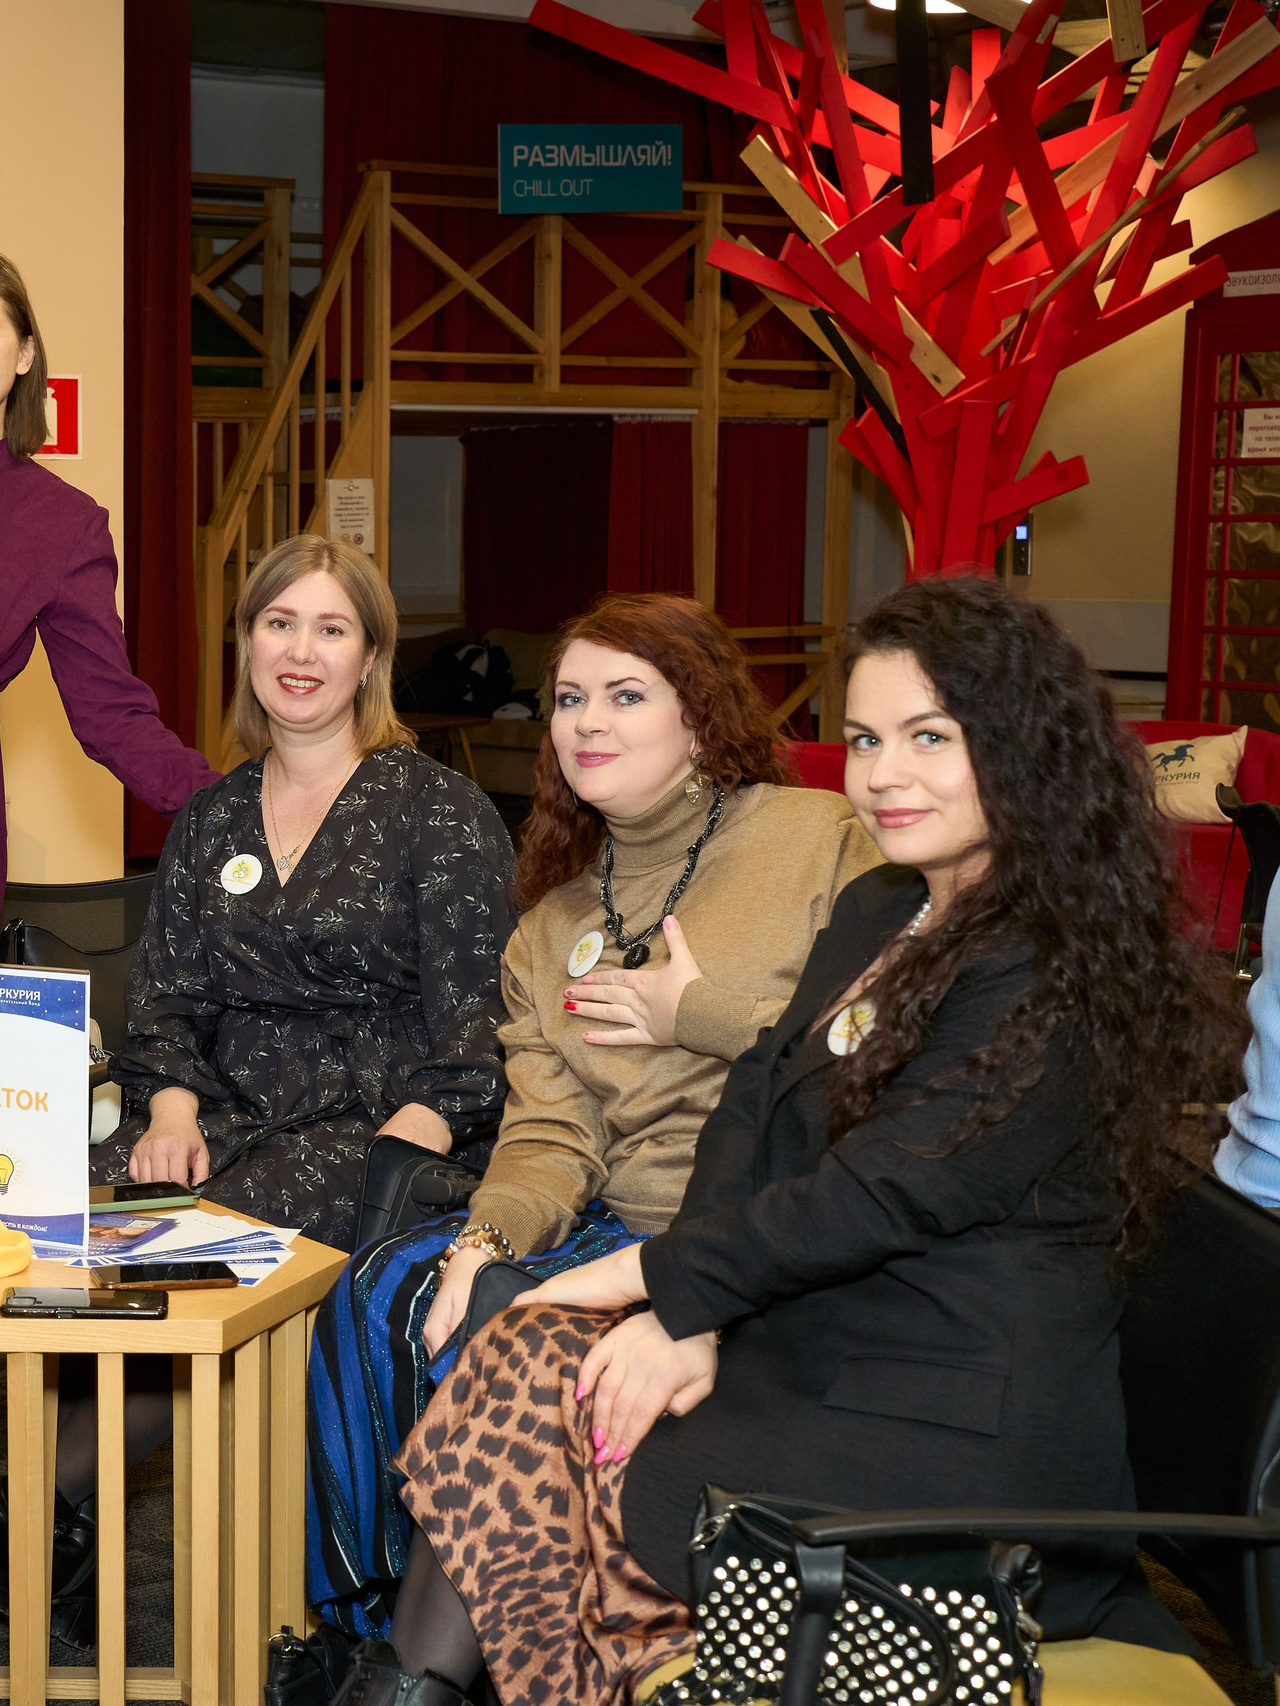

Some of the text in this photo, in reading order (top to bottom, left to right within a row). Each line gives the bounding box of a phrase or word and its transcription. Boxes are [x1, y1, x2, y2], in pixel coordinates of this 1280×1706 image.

[513, 140, 672, 168] РАЗМЫШЛЯЙ!
[513, 179, 594, 197] CHILL OUT
[1155, 772, 1200, 782] РКУРИЯ
